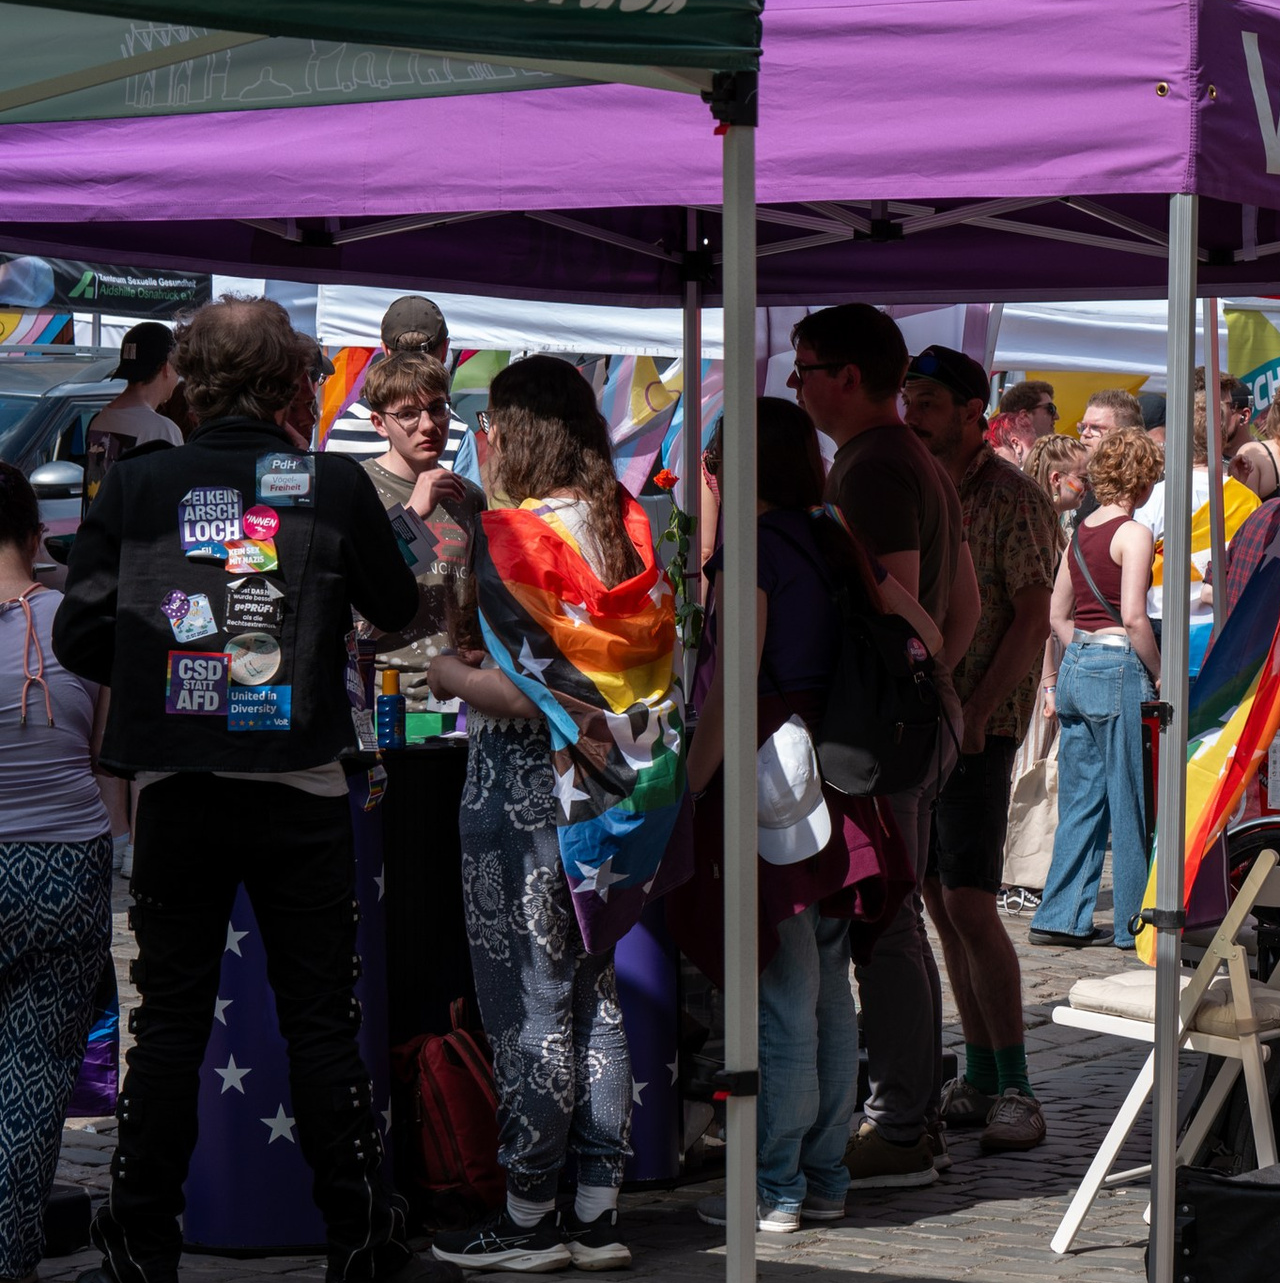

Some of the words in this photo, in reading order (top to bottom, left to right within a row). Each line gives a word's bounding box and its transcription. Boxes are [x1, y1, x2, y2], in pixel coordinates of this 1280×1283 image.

[127, 276, 157, 286] Sexuelle
[158, 278, 196, 288] Gesundheit
[99, 285, 136, 297] Aidshilfe
[137, 288, 179, 300] Osnabrück
[180, 291, 196, 301] e.V.
[272, 460, 297, 470] PdH
[270, 484, 301, 492] Freiheit
[206, 489, 238, 504] KEIN
[184, 505, 239, 521] ARSCH
[184, 520, 240, 542] LOCH
[229, 547, 246, 556] KEIN
[246, 546, 260, 555] SEX
[229, 556, 243, 566] MIT
[243, 554, 265, 565] NAZIS
[233, 593, 253, 601] wurde
[178, 658, 223, 680] CSD
[183, 679, 215, 691] STATT
[176, 690, 219, 711] AFD
[231, 690, 266, 701] United
[267, 690, 277, 701] in
[231, 703, 277, 715] Diversity
[274, 718, 289, 726] Volt
